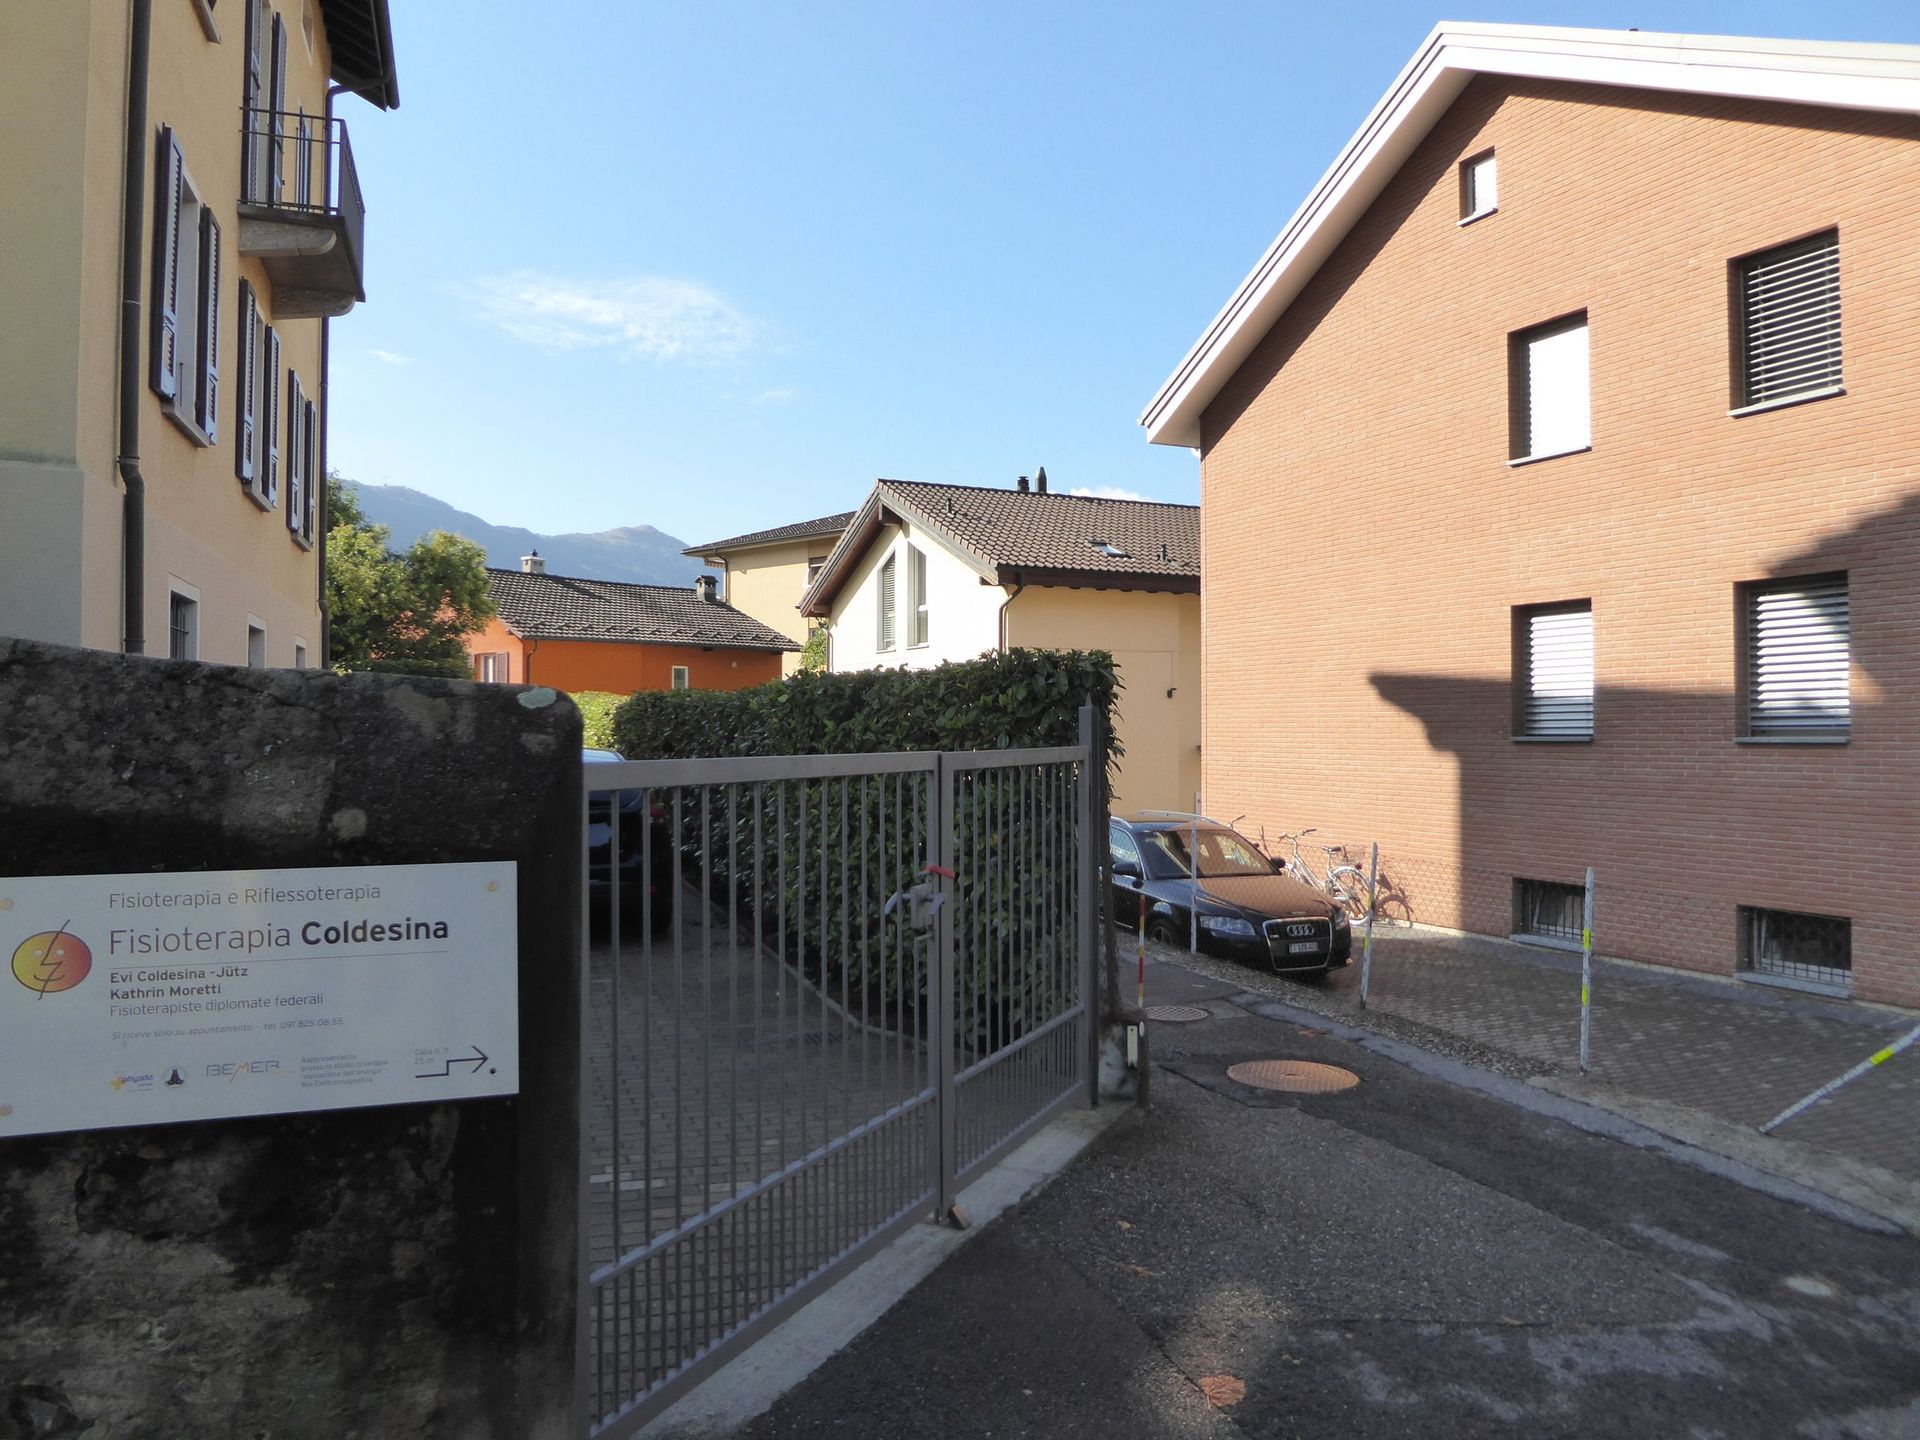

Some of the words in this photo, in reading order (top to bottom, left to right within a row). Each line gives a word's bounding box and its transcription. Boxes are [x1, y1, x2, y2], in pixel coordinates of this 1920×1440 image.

[109, 892, 221, 909] Fisioterapia
[228, 892, 239, 904] e
[245, 884, 381, 904] Riflessoterapia
[109, 923, 290, 955] Fisioterapia
[301, 917, 449, 945] Coldesina
[110, 971, 133, 983] Evi
[137, 969, 206, 982] Coldesina
[110, 987, 165, 1000] Kathrin
[169, 983, 222, 997] Moretti
[110, 1002, 202, 1016] Fisioterapiste
[205, 997, 271, 1013] diplomate
[275, 993, 324, 1008] federali
[122, 1030, 151, 1040] riceve
[154, 1028, 172, 1037] solo
[187, 1024, 254, 1036] appuntamento
[280, 1020, 296, 1030] 091
[297, 1019, 315, 1028] 825
[206, 1060, 279, 1087] BEMER
